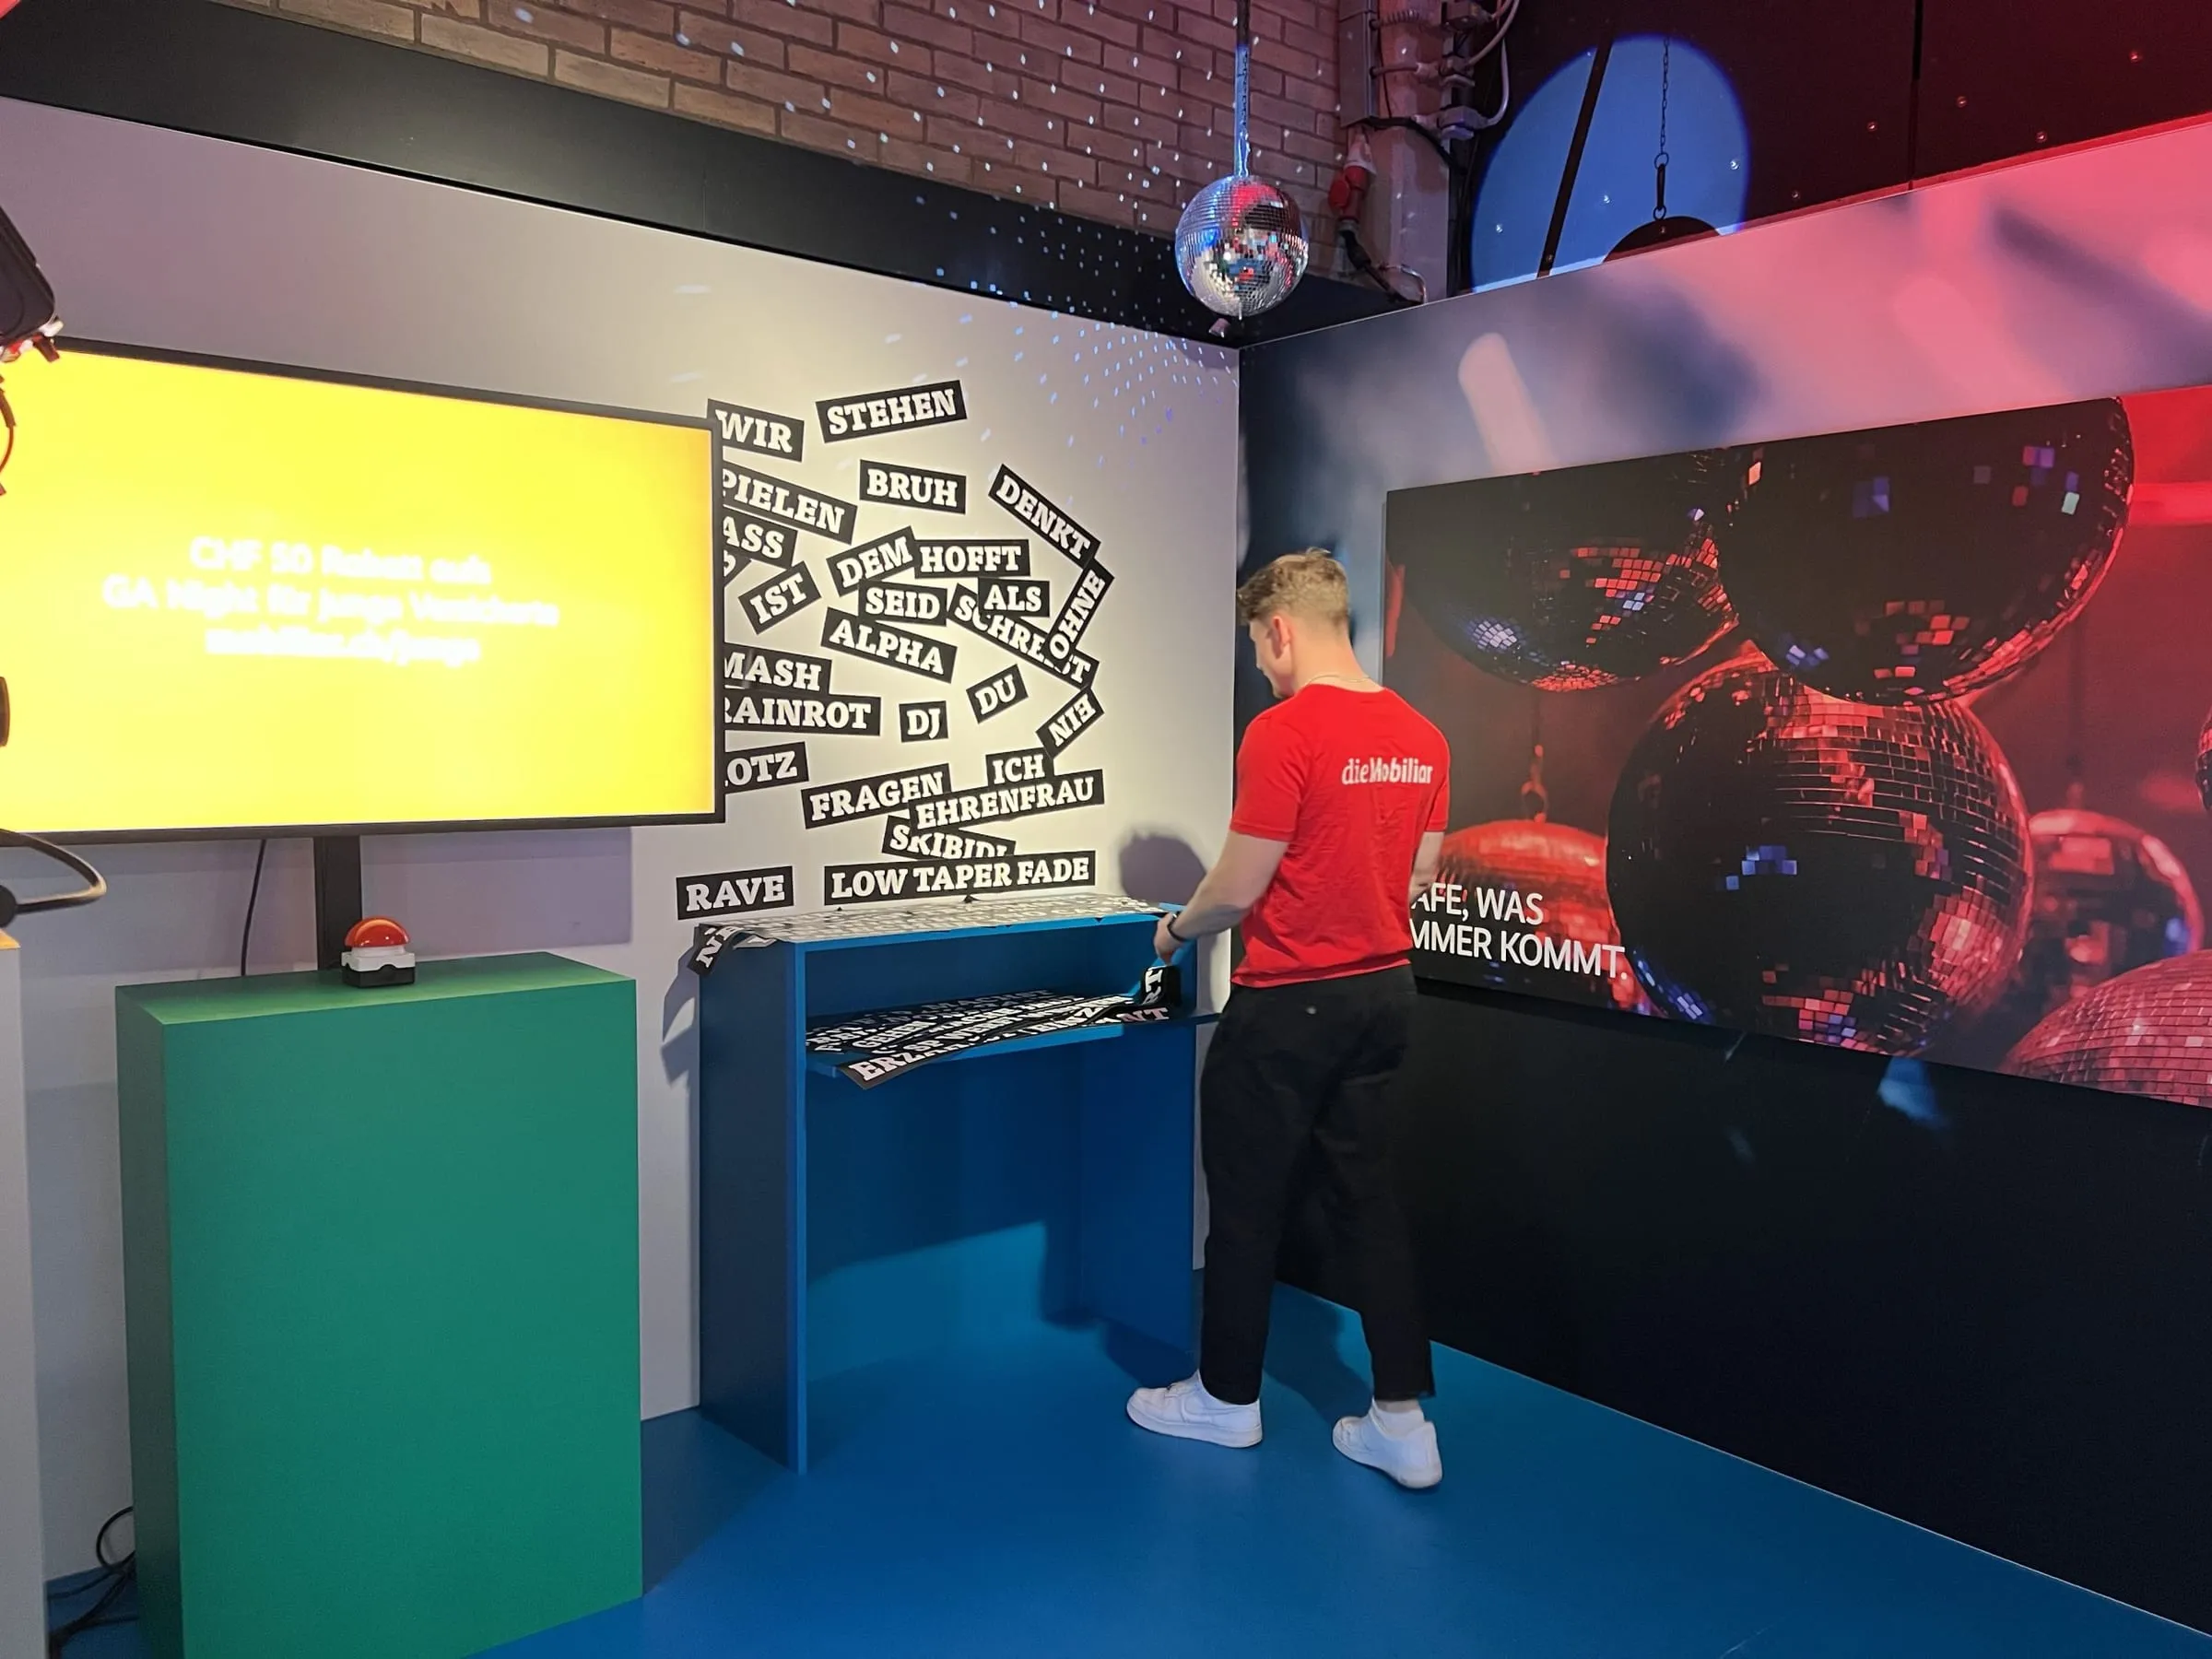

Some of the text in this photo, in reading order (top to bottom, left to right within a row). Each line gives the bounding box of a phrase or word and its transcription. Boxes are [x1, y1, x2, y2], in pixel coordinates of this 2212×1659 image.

[715, 409, 793, 453] WIR
[826, 388, 957, 435] STEHEN
[866, 468, 959, 507] BRUH
[995, 475, 1091, 560] DENKT
[189, 535, 263, 571] CHF
[836, 535, 913, 588] DEM
[920, 545, 1021, 572] HOFFT
[101, 573, 159, 608] GA
[749, 571, 808, 625] IST
[865, 588, 940, 620] SEID
[983, 584, 1041, 612] ALS
[1049, 570, 1106, 659] OHNE
[830, 619, 944, 676] ALPHA
[954, 594, 1091, 684] SCHRET
[974, 674, 1017, 715] DU
[906, 707, 942, 739] DJ
[724, 750, 797, 787] OTZ
[993, 754, 1045, 784] ICH
[1342, 758, 1433, 785] dieMobiliar
[809, 771, 944, 821] FRAGEN
[916, 777, 1094, 830] EHRENFRAU
[686, 875, 785, 912] RAVE
[831, 857, 1090, 900] LOW TAPER FADE
[1477, 887, 1544, 924] WAS
[1500, 930, 1628, 980] KOMMT.
[852, 1020, 936, 1048] GEHEN
